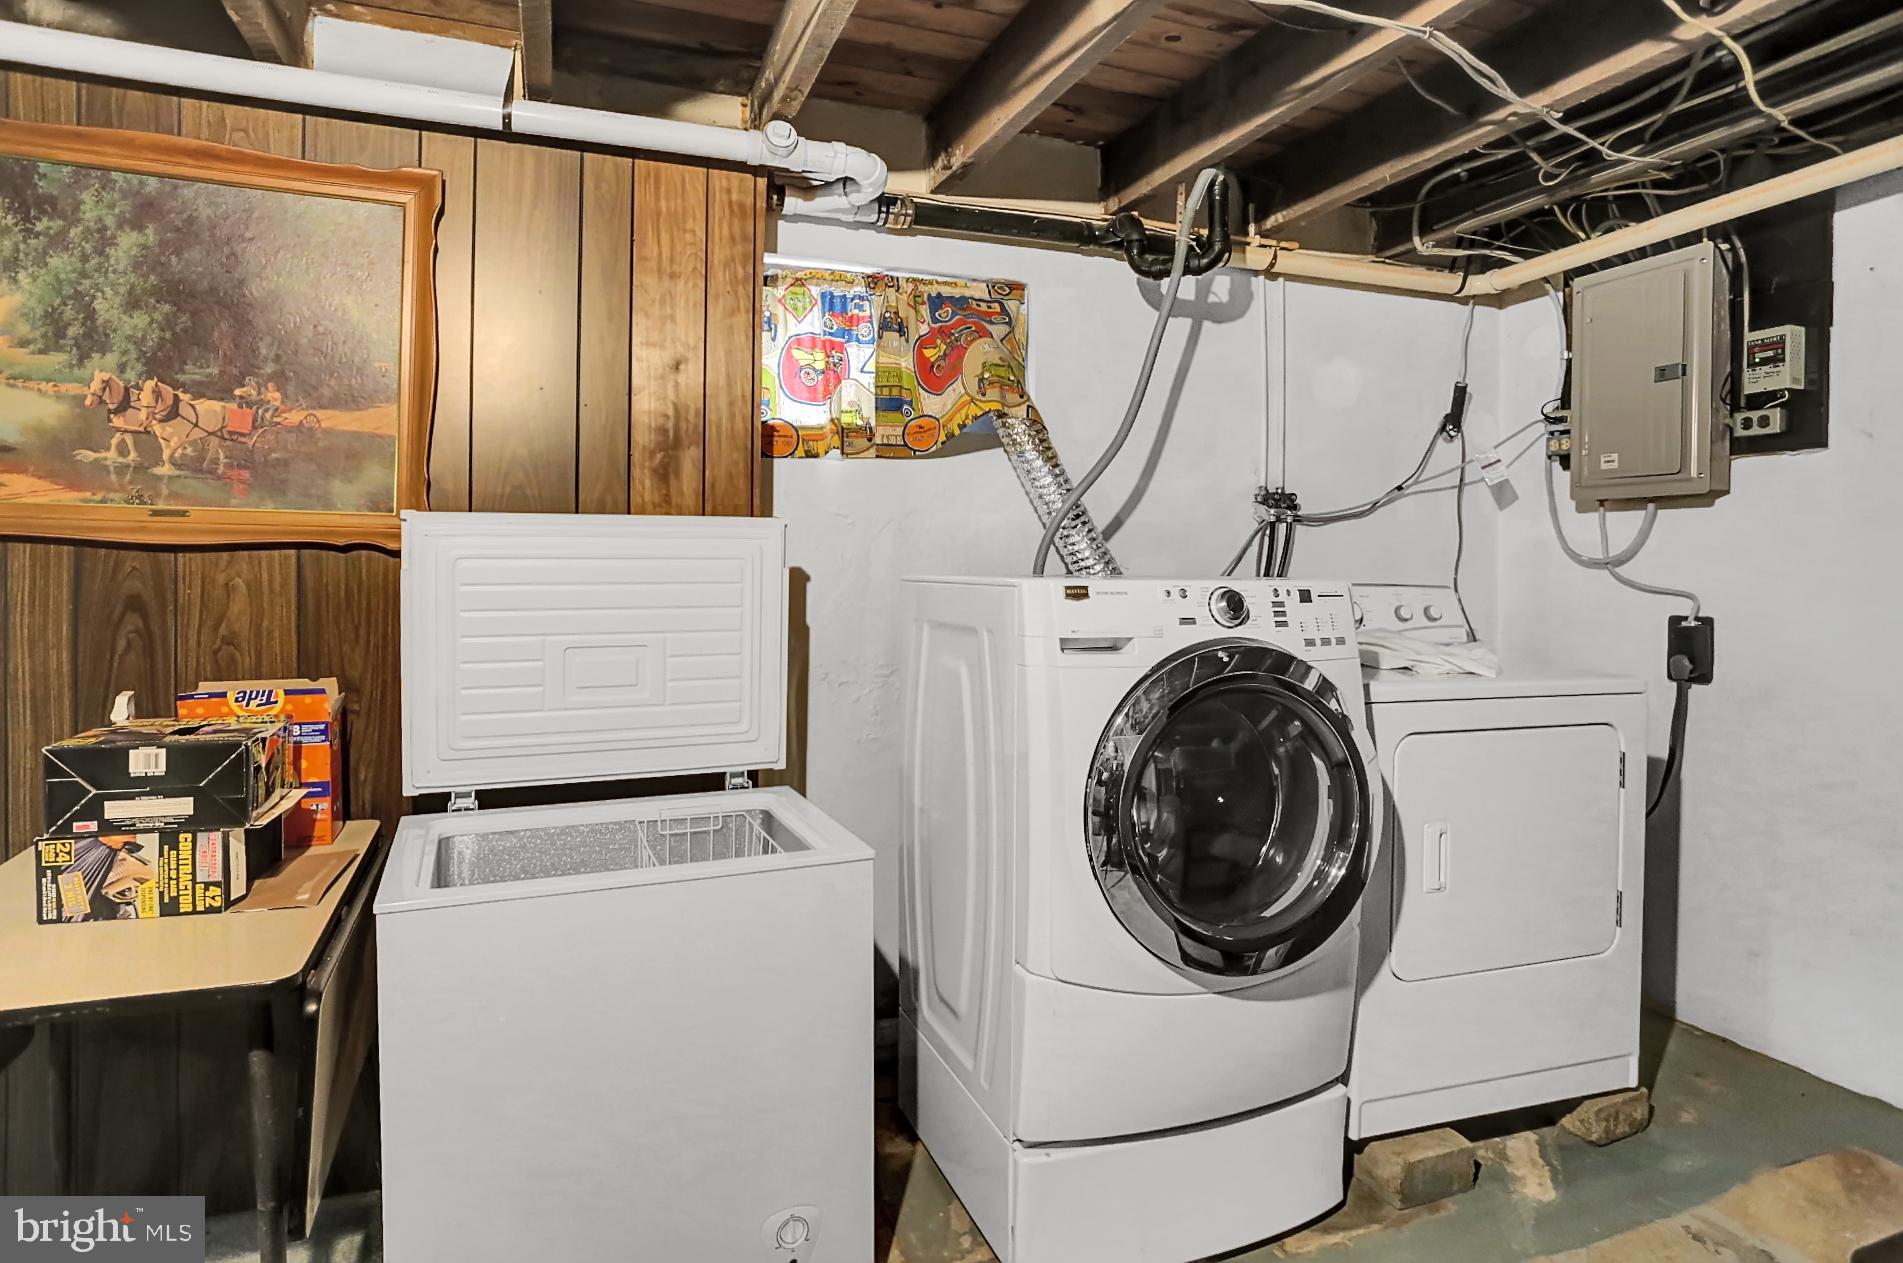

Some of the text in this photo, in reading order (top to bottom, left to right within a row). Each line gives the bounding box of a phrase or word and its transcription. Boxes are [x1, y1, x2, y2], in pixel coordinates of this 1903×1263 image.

[234, 689, 278, 708] Tide
[55, 842, 71, 863] 24
[178, 832, 193, 912] CONTRACTOR
[195, 883, 205, 912] GALLON
[205, 885, 222, 908] 42
